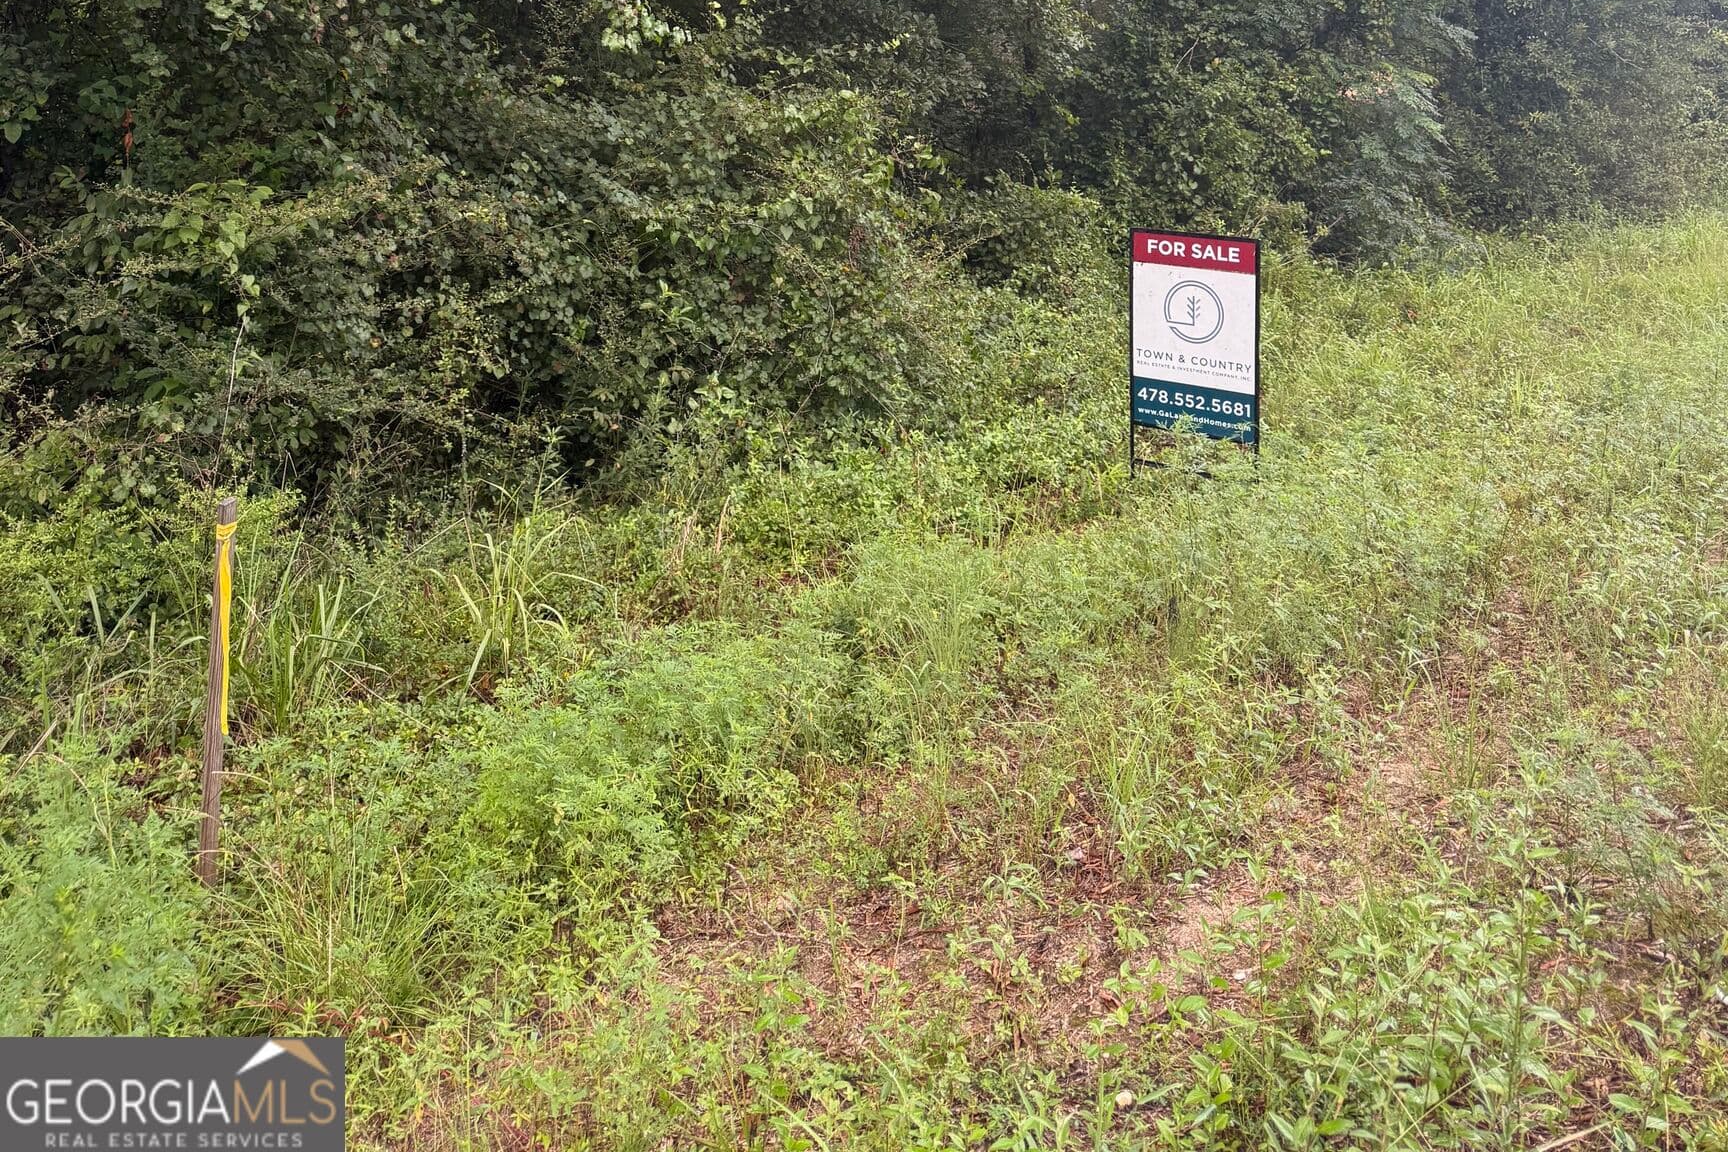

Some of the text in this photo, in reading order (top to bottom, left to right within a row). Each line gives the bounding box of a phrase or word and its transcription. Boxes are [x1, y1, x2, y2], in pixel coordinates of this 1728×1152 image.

[1147, 239, 1240, 263] FOR SALE
[1136, 348, 1252, 374] TOWN & COUNTRY
[1177, 366, 1210, 375] INVESTMENT
[1137, 386, 1251, 418] 478.552.5681
